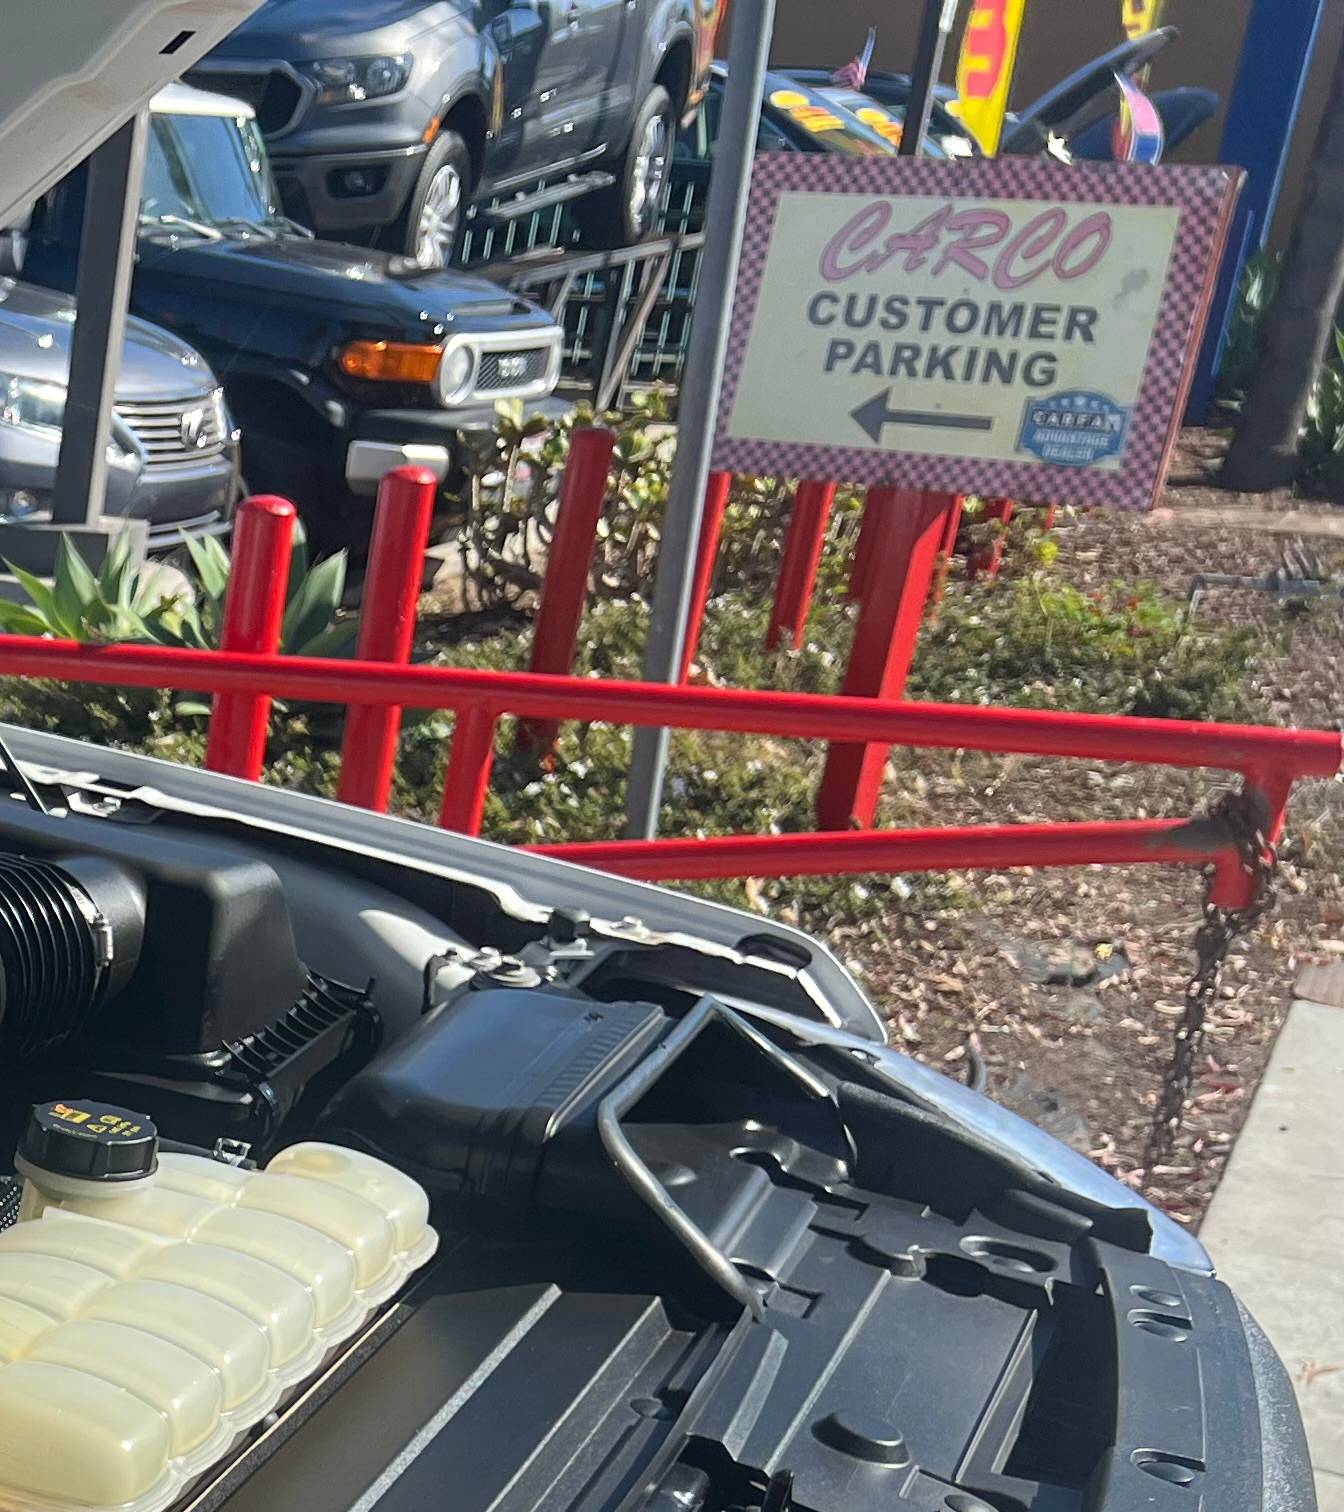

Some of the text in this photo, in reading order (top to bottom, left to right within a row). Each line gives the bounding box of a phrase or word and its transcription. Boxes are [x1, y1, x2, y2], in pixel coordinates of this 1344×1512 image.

[819, 200, 1113, 291] CARCO
[808, 290, 1099, 344] CUSTOMER
[823, 338, 1058, 387] PARKING
